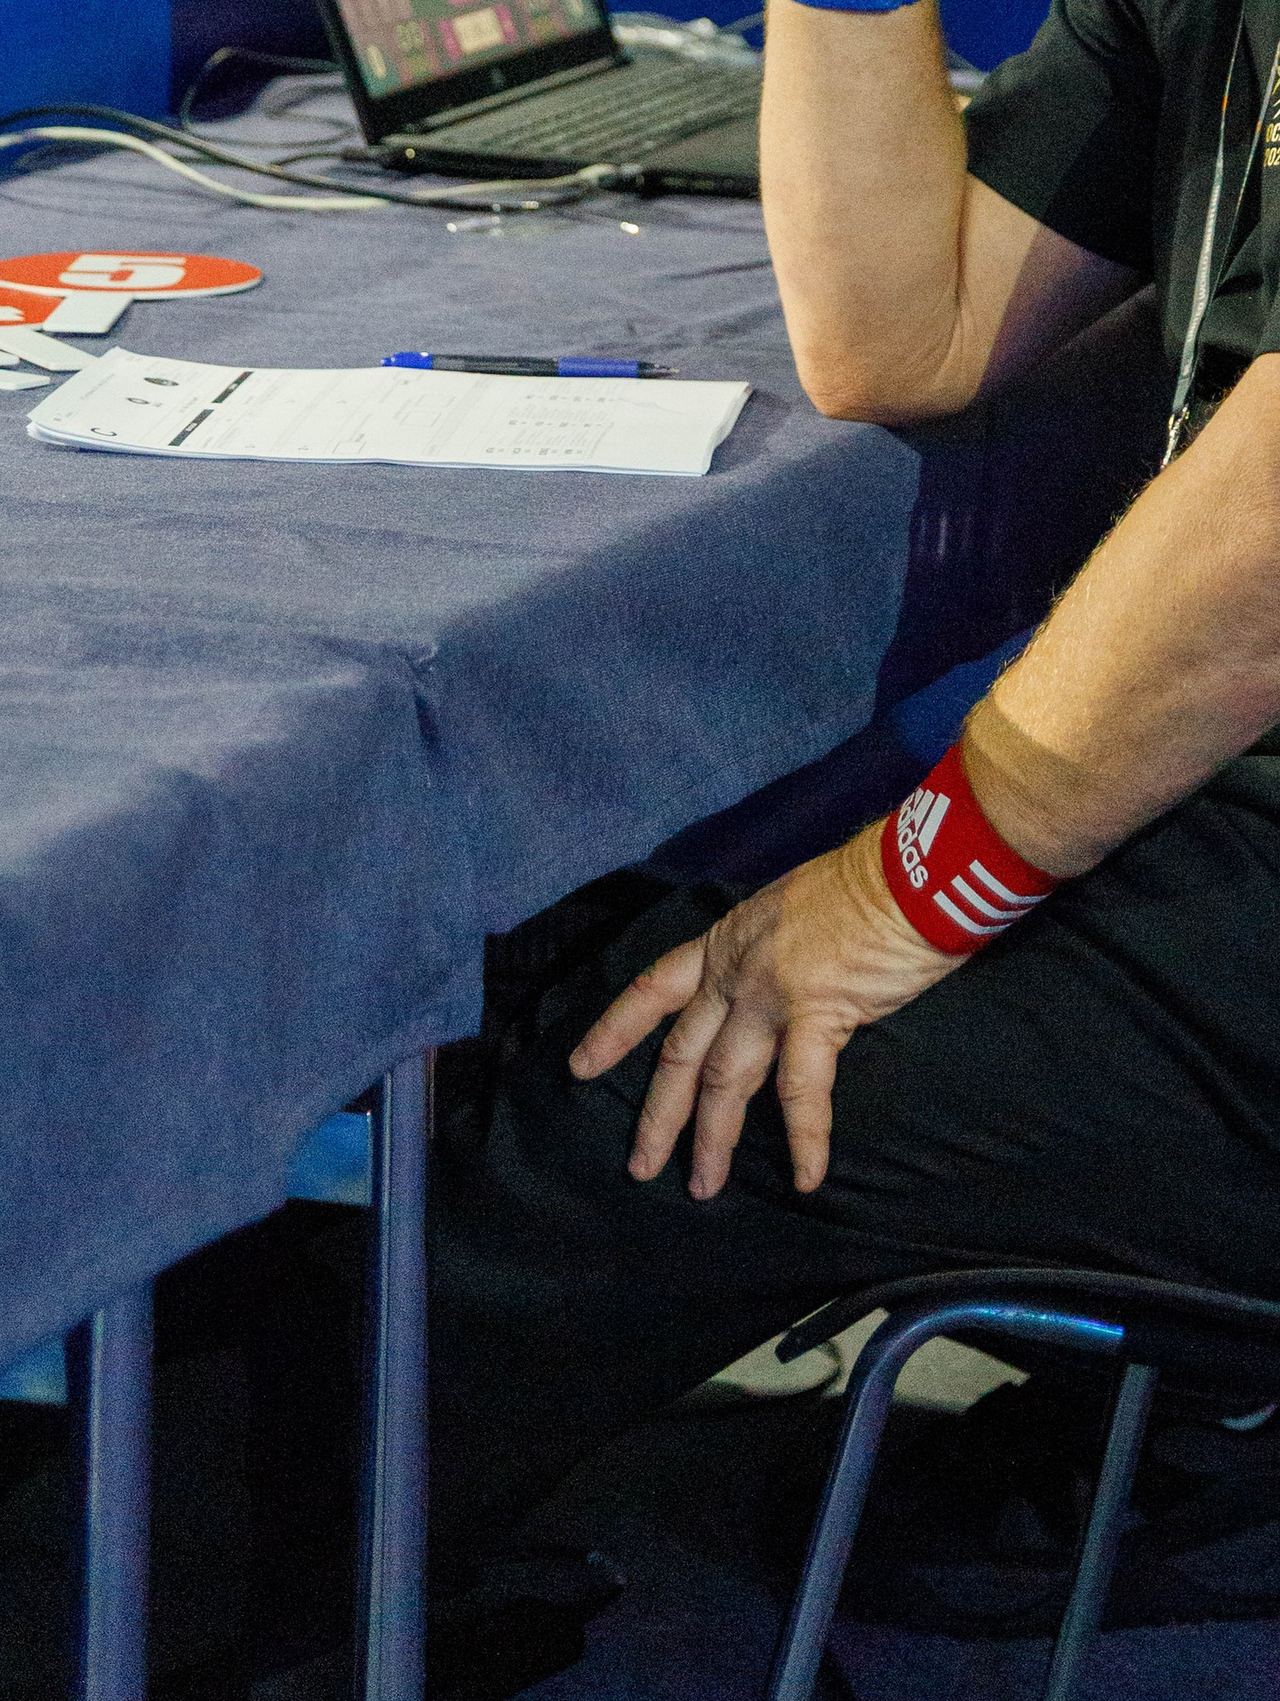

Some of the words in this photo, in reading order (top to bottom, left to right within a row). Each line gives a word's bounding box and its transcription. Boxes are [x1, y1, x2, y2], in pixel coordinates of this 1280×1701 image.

[58, 253, 187, 289] 5
[1198, 255, 1211, 300] WORLD
[896, 792, 930, 889] adidas
